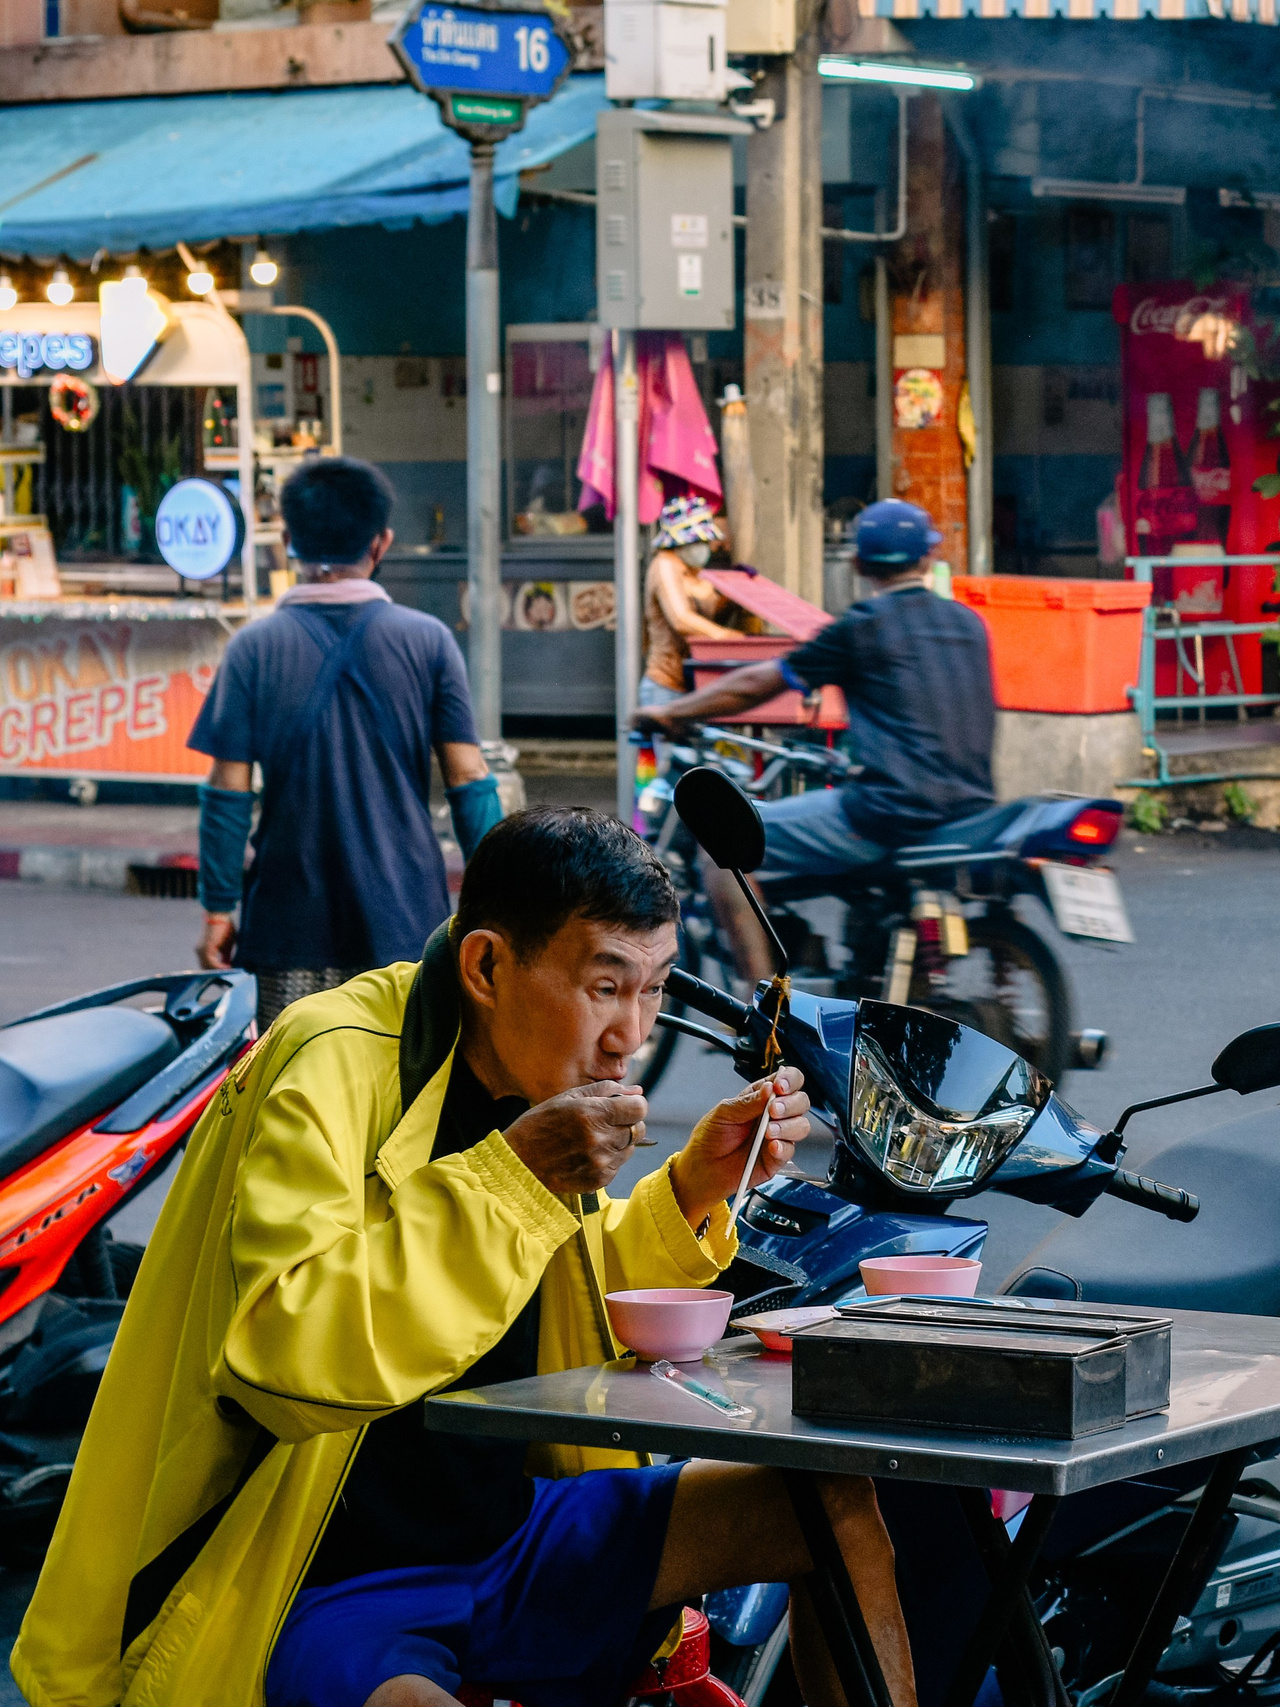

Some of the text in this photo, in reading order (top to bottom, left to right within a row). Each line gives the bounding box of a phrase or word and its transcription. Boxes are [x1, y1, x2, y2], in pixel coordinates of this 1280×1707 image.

[514, 26, 549, 73] 16
[156, 515, 221, 547] OKAY
[6, 623, 134, 702] OKAY
[0, 675, 166, 762] CREPE
